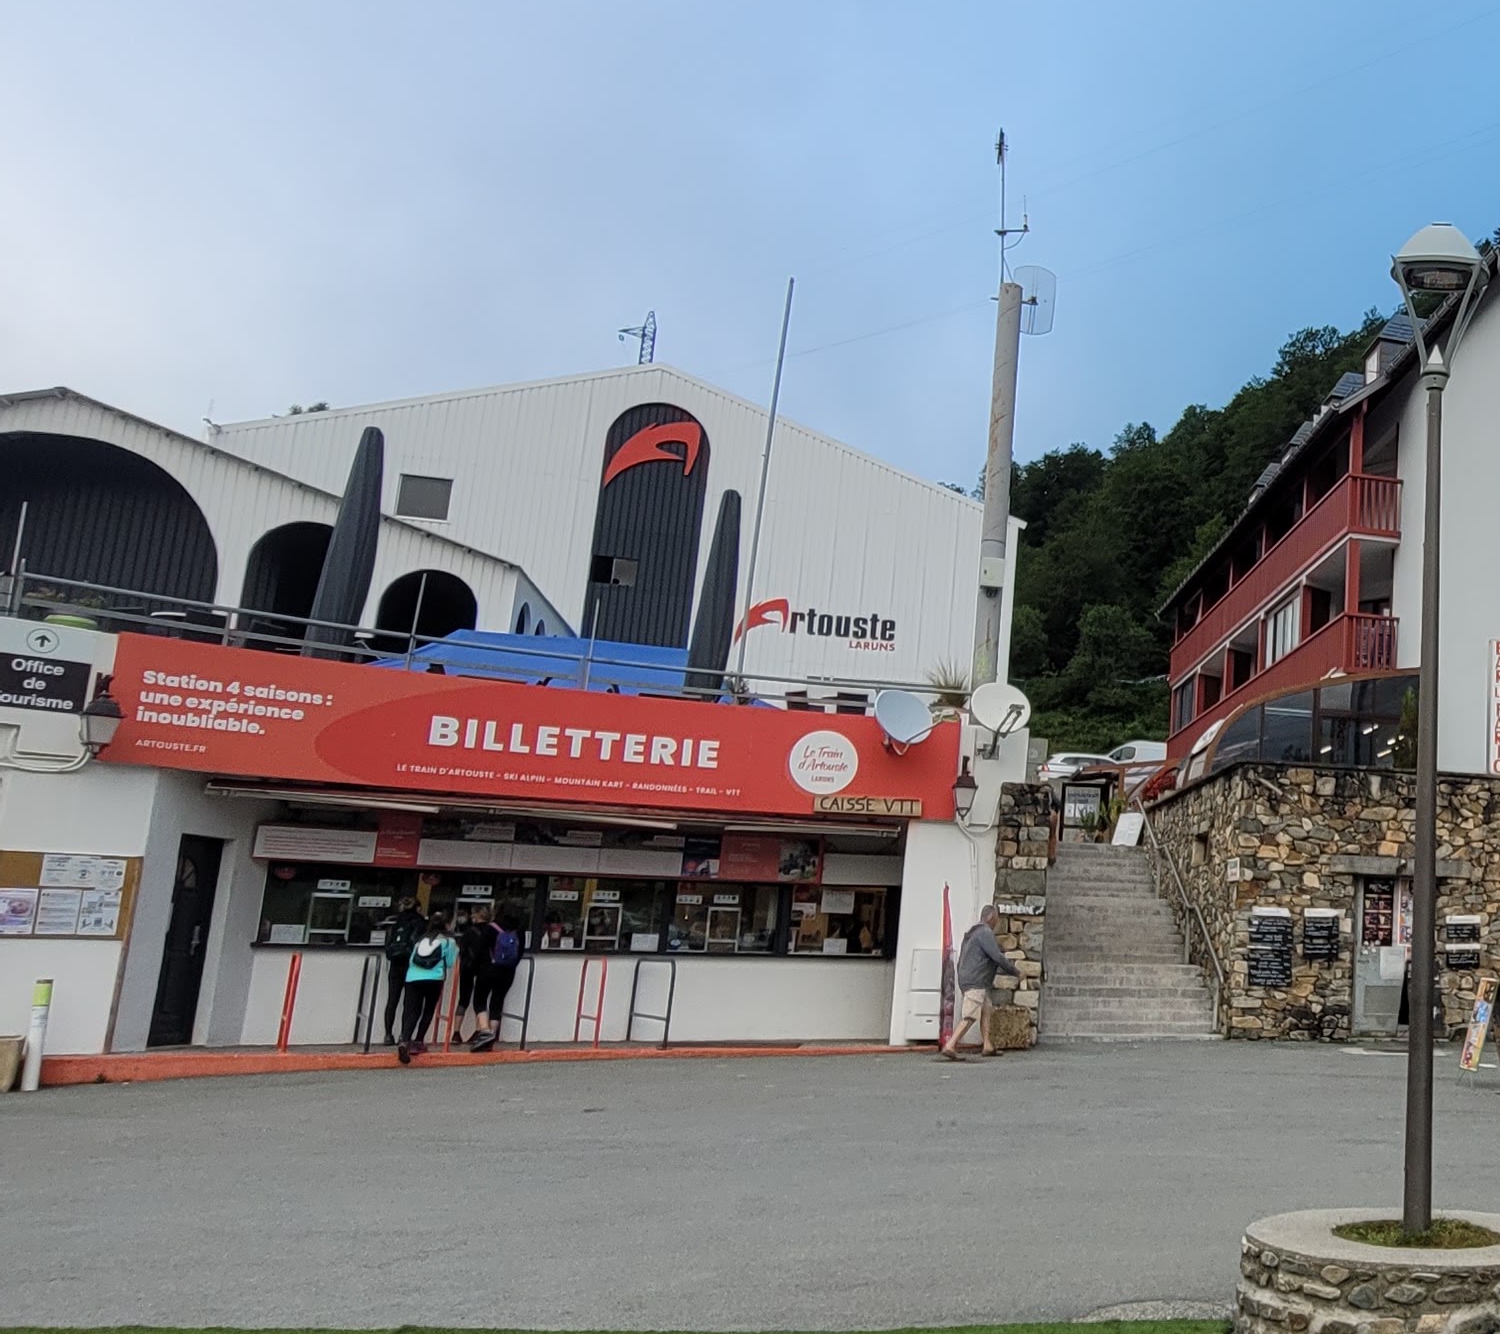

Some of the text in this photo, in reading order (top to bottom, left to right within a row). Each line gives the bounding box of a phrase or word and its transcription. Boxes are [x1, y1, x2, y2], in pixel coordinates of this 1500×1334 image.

[849, 641, 896, 652] LARUNS
[11, 658, 65, 676] Office
[22, 677, 47, 690] de
[143, 670, 223, 693] Station
[226, 681, 240, 694] 4
[244, 685, 323, 705] saisons
[0, 692, 74, 710] ourisme
[139, 690, 305, 720] une expérience
[135, 706, 266, 735] inoubliable.
[135, 739, 207, 753] ARTOUSTE.FR
[427, 715, 721, 769] BILLETTERIE
[803, 745, 844, 759] Le Train
[396, 763, 408, 772] LE
[410, 765, 437, 774] TRAIN
[439, 767, 495, 779] D'ARTOUSTE
[519, 774, 546, 783] ALPIN
[554, 777, 601, 787] MOUNTAIN
[602, 780, 624, 788] KART
[695, 787, 718, 795] TRAIL
[726, 789, 741, 797] VTT
[819, 795, 916, 814] CAISSE VTT
